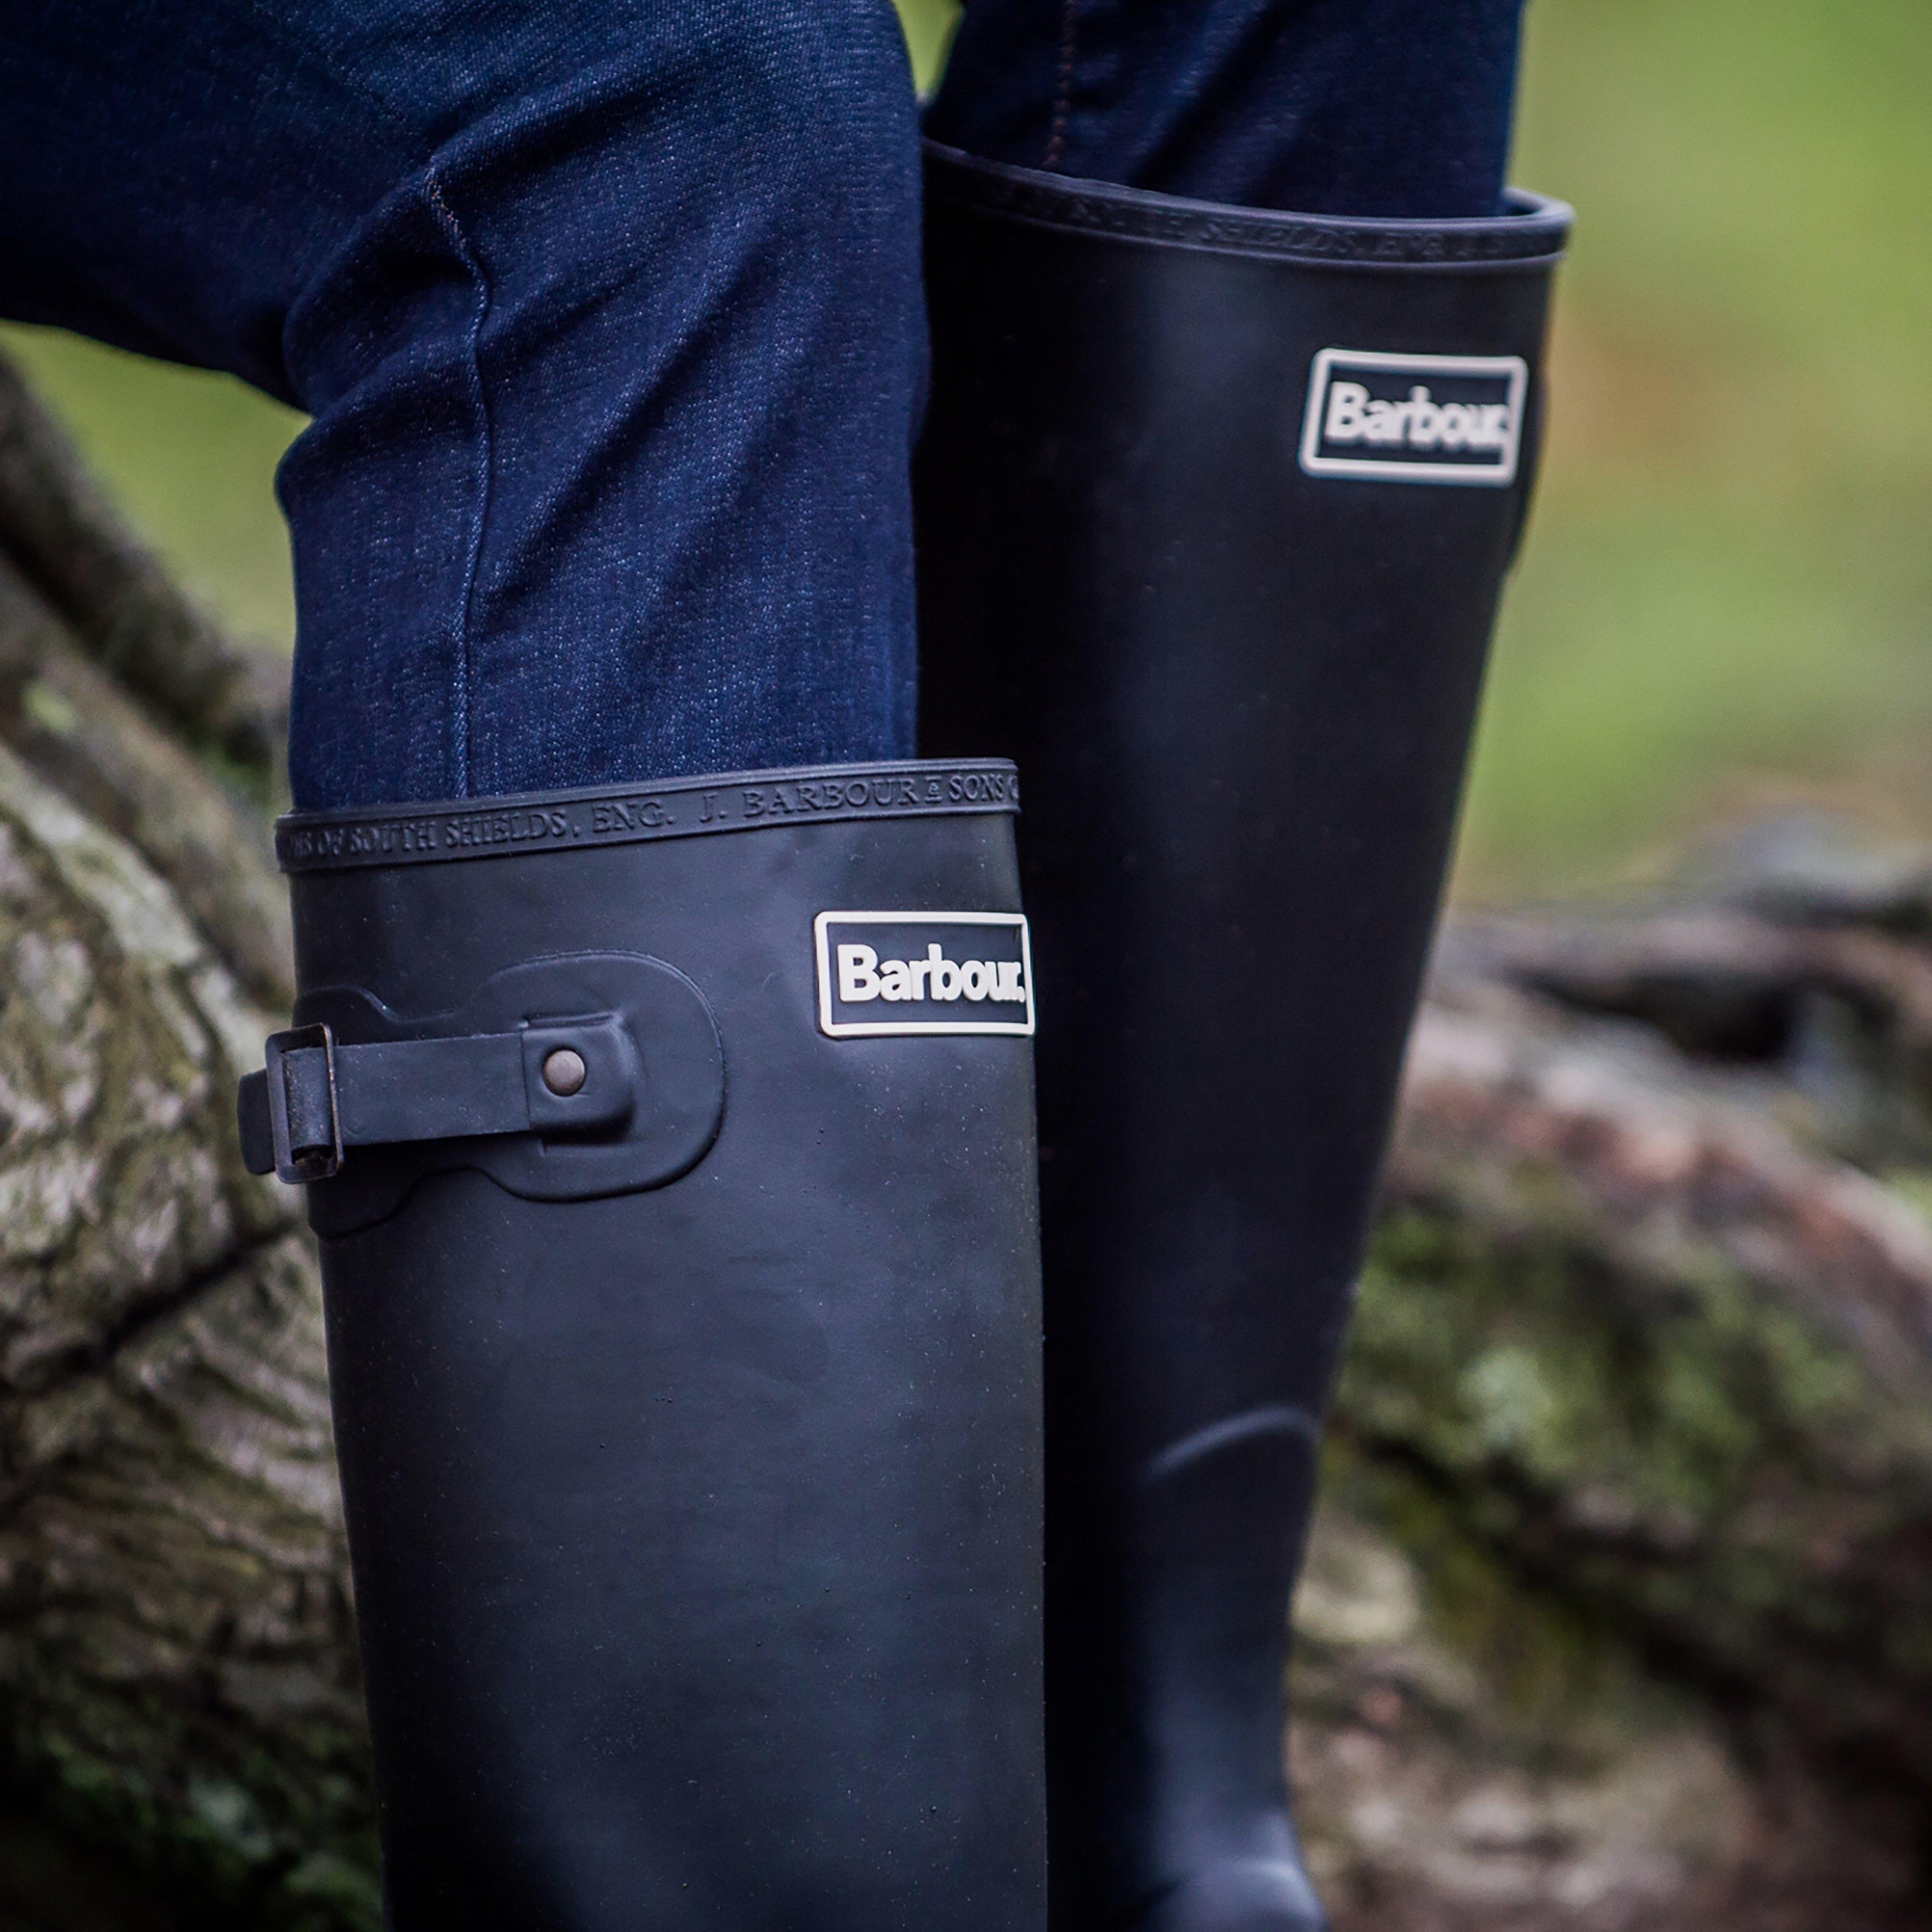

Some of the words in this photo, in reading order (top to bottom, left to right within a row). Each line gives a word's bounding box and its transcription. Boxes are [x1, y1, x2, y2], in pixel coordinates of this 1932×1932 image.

[349, 820, 437, 855] SOUTH
[740, 776, 919, 819] BARBOUR
[944, 773, 1004, 803] SONS
